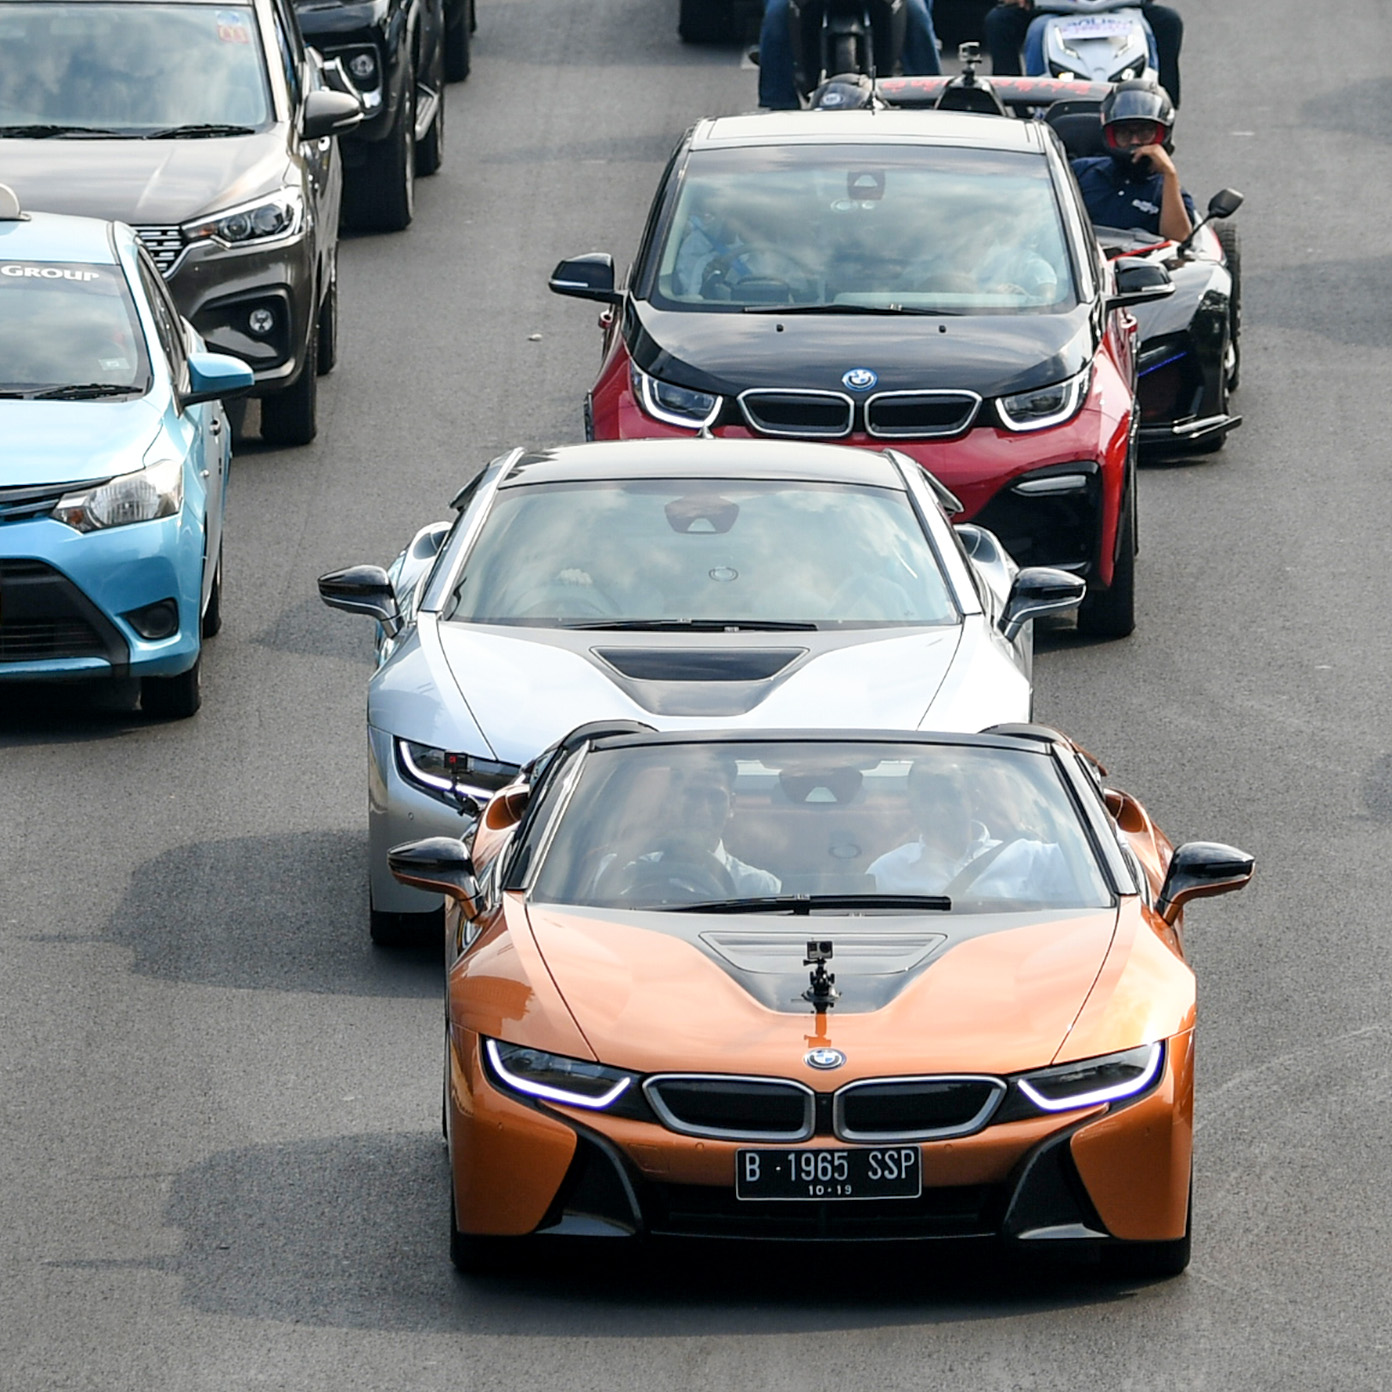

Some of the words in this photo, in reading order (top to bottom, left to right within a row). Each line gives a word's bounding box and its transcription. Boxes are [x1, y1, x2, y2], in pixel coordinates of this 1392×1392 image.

[0, 265, 100, 282] GROUP
[745, 1152, 761, 1182] B
[787, 1151, 849, 1182] 1965
[867, 1149, 916, 1181] SSP
